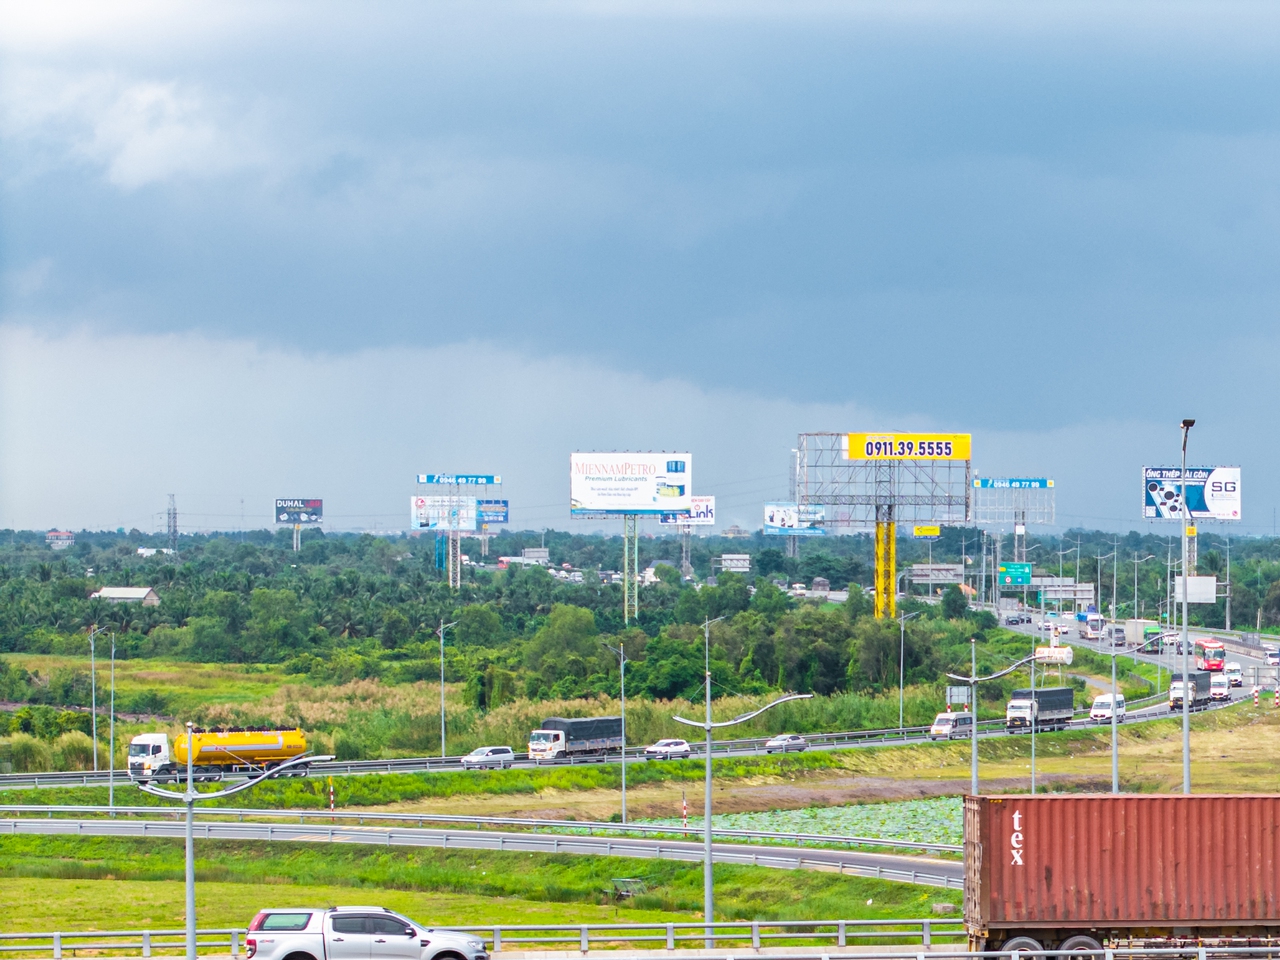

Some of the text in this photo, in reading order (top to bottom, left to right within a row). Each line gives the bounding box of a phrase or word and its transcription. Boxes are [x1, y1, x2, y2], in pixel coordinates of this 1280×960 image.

[866, 442, 952, 456] 0911.39.5555
[1146, 469, 1161, 478] ỐNG
[1162, 469, 1180, 478] THÉP
[1193, 470, 1208, 478] GÒN
[1212, 482, 1236, 492] SG
[1011, 810, 1024, 866] tex
